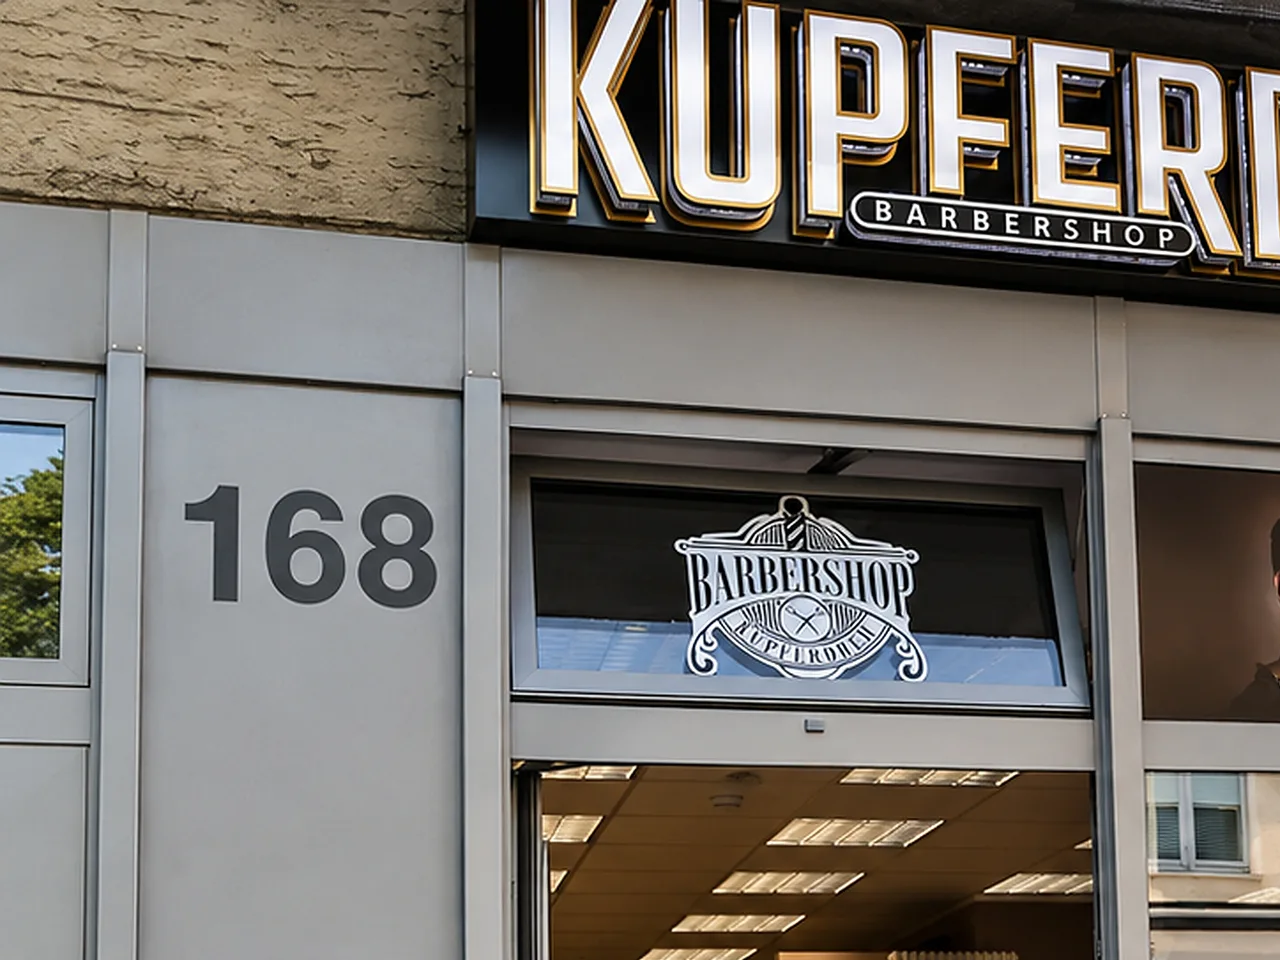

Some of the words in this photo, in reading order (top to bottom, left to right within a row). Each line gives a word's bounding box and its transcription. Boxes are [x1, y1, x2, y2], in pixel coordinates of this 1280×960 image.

[874, 199, 1175, 249] BARBERSHOP
[184, 485, 438, 609] 168
[690, 553, 910, 617] BARBERSHOP
